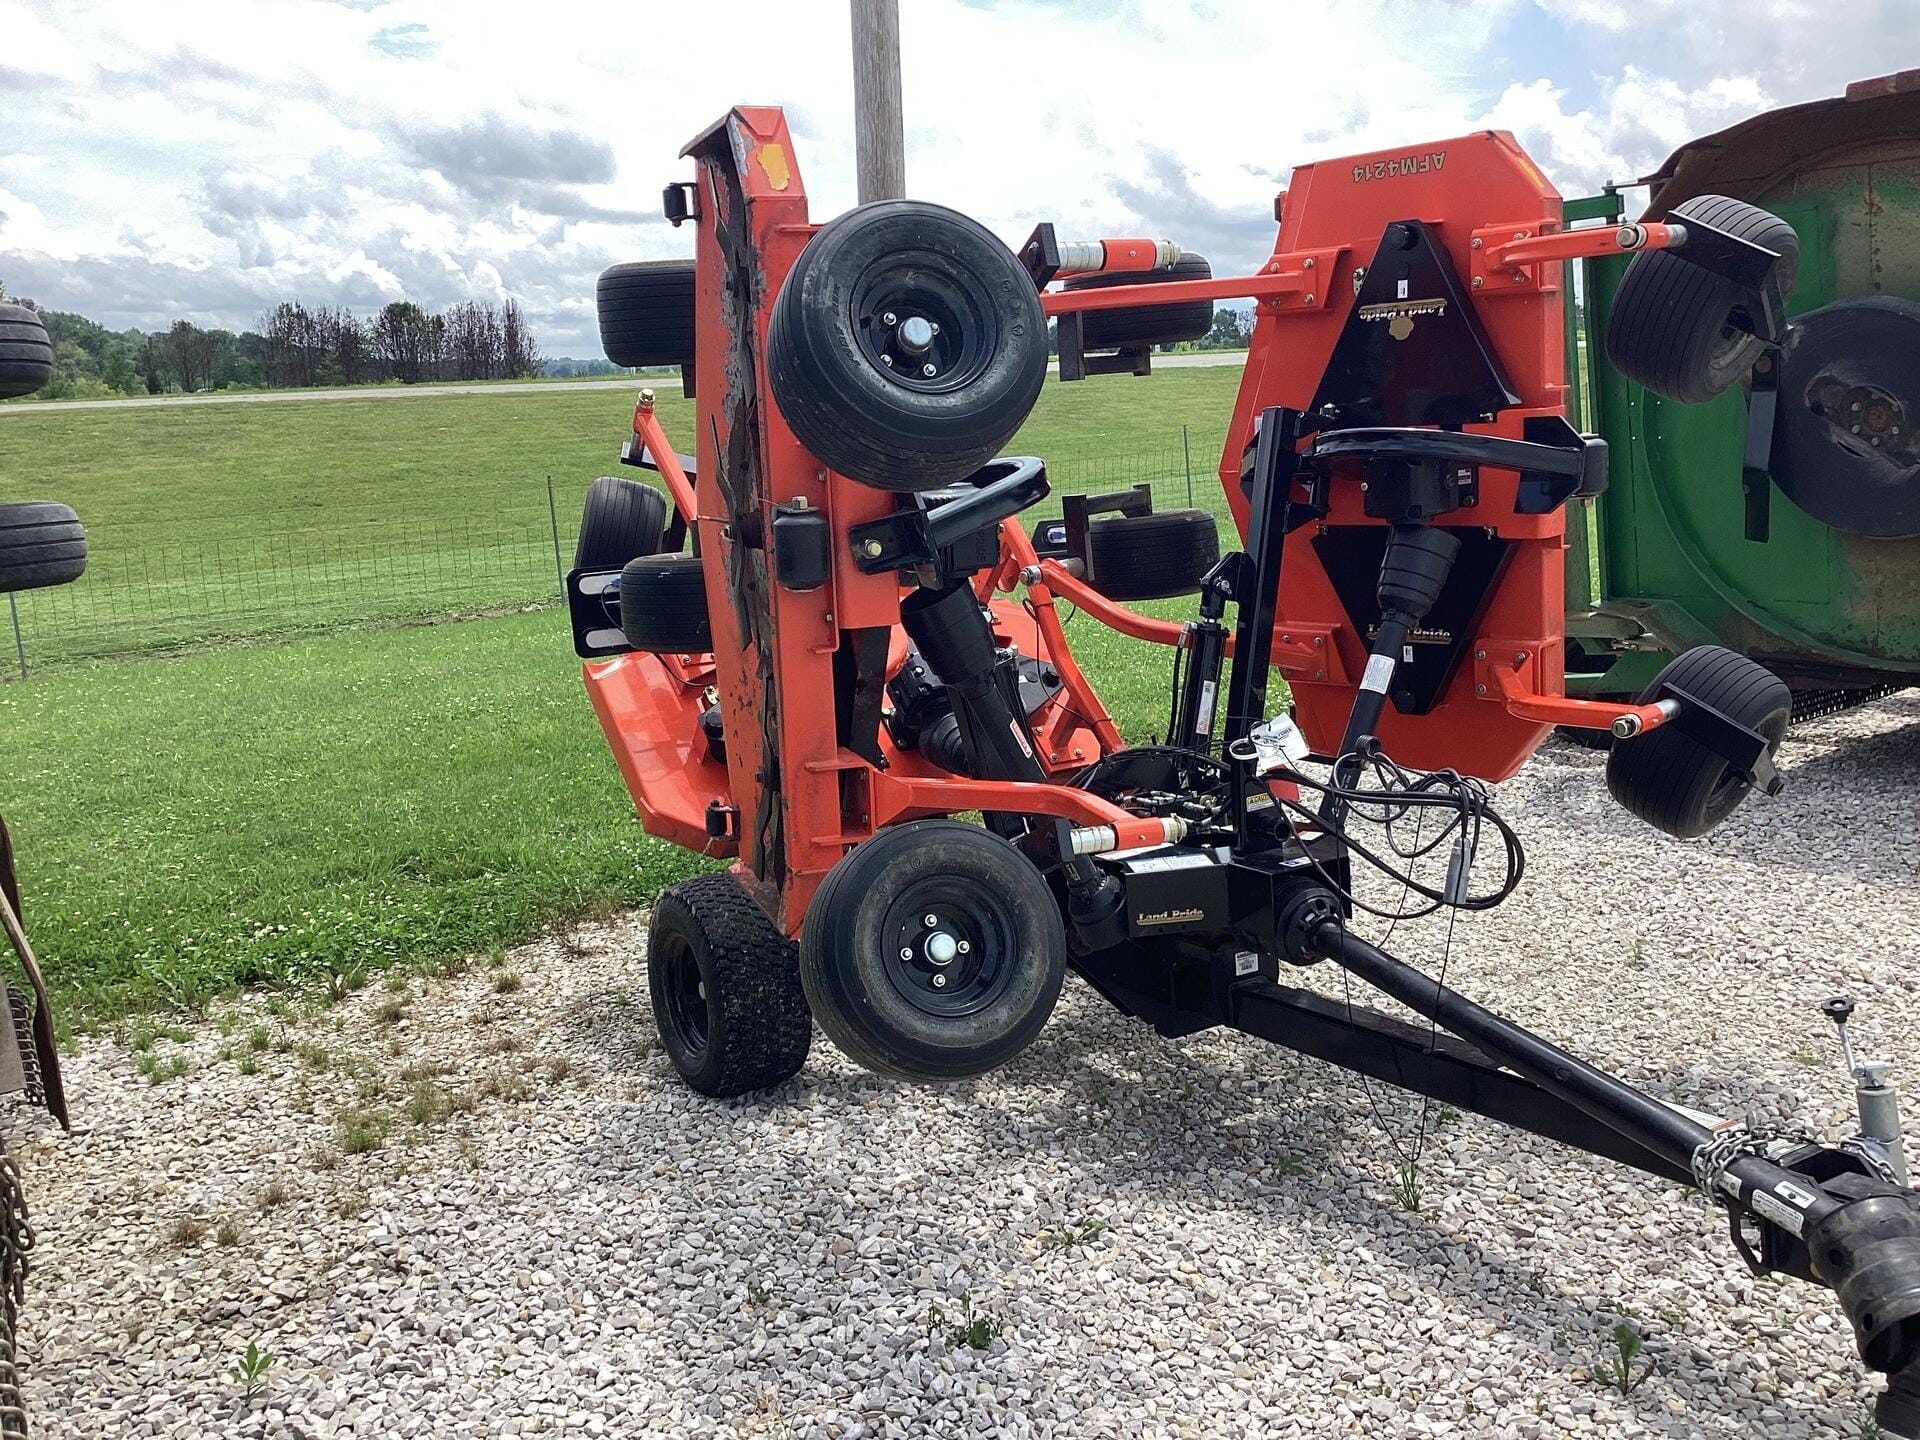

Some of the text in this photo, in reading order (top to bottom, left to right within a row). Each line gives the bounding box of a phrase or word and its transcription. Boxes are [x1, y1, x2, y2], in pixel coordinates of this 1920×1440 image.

[1352, 152, 1446, 183] AFM4214
[1406, 302, 1447, 318] Land
[1138, 908, 1204, 923] Land Pride
